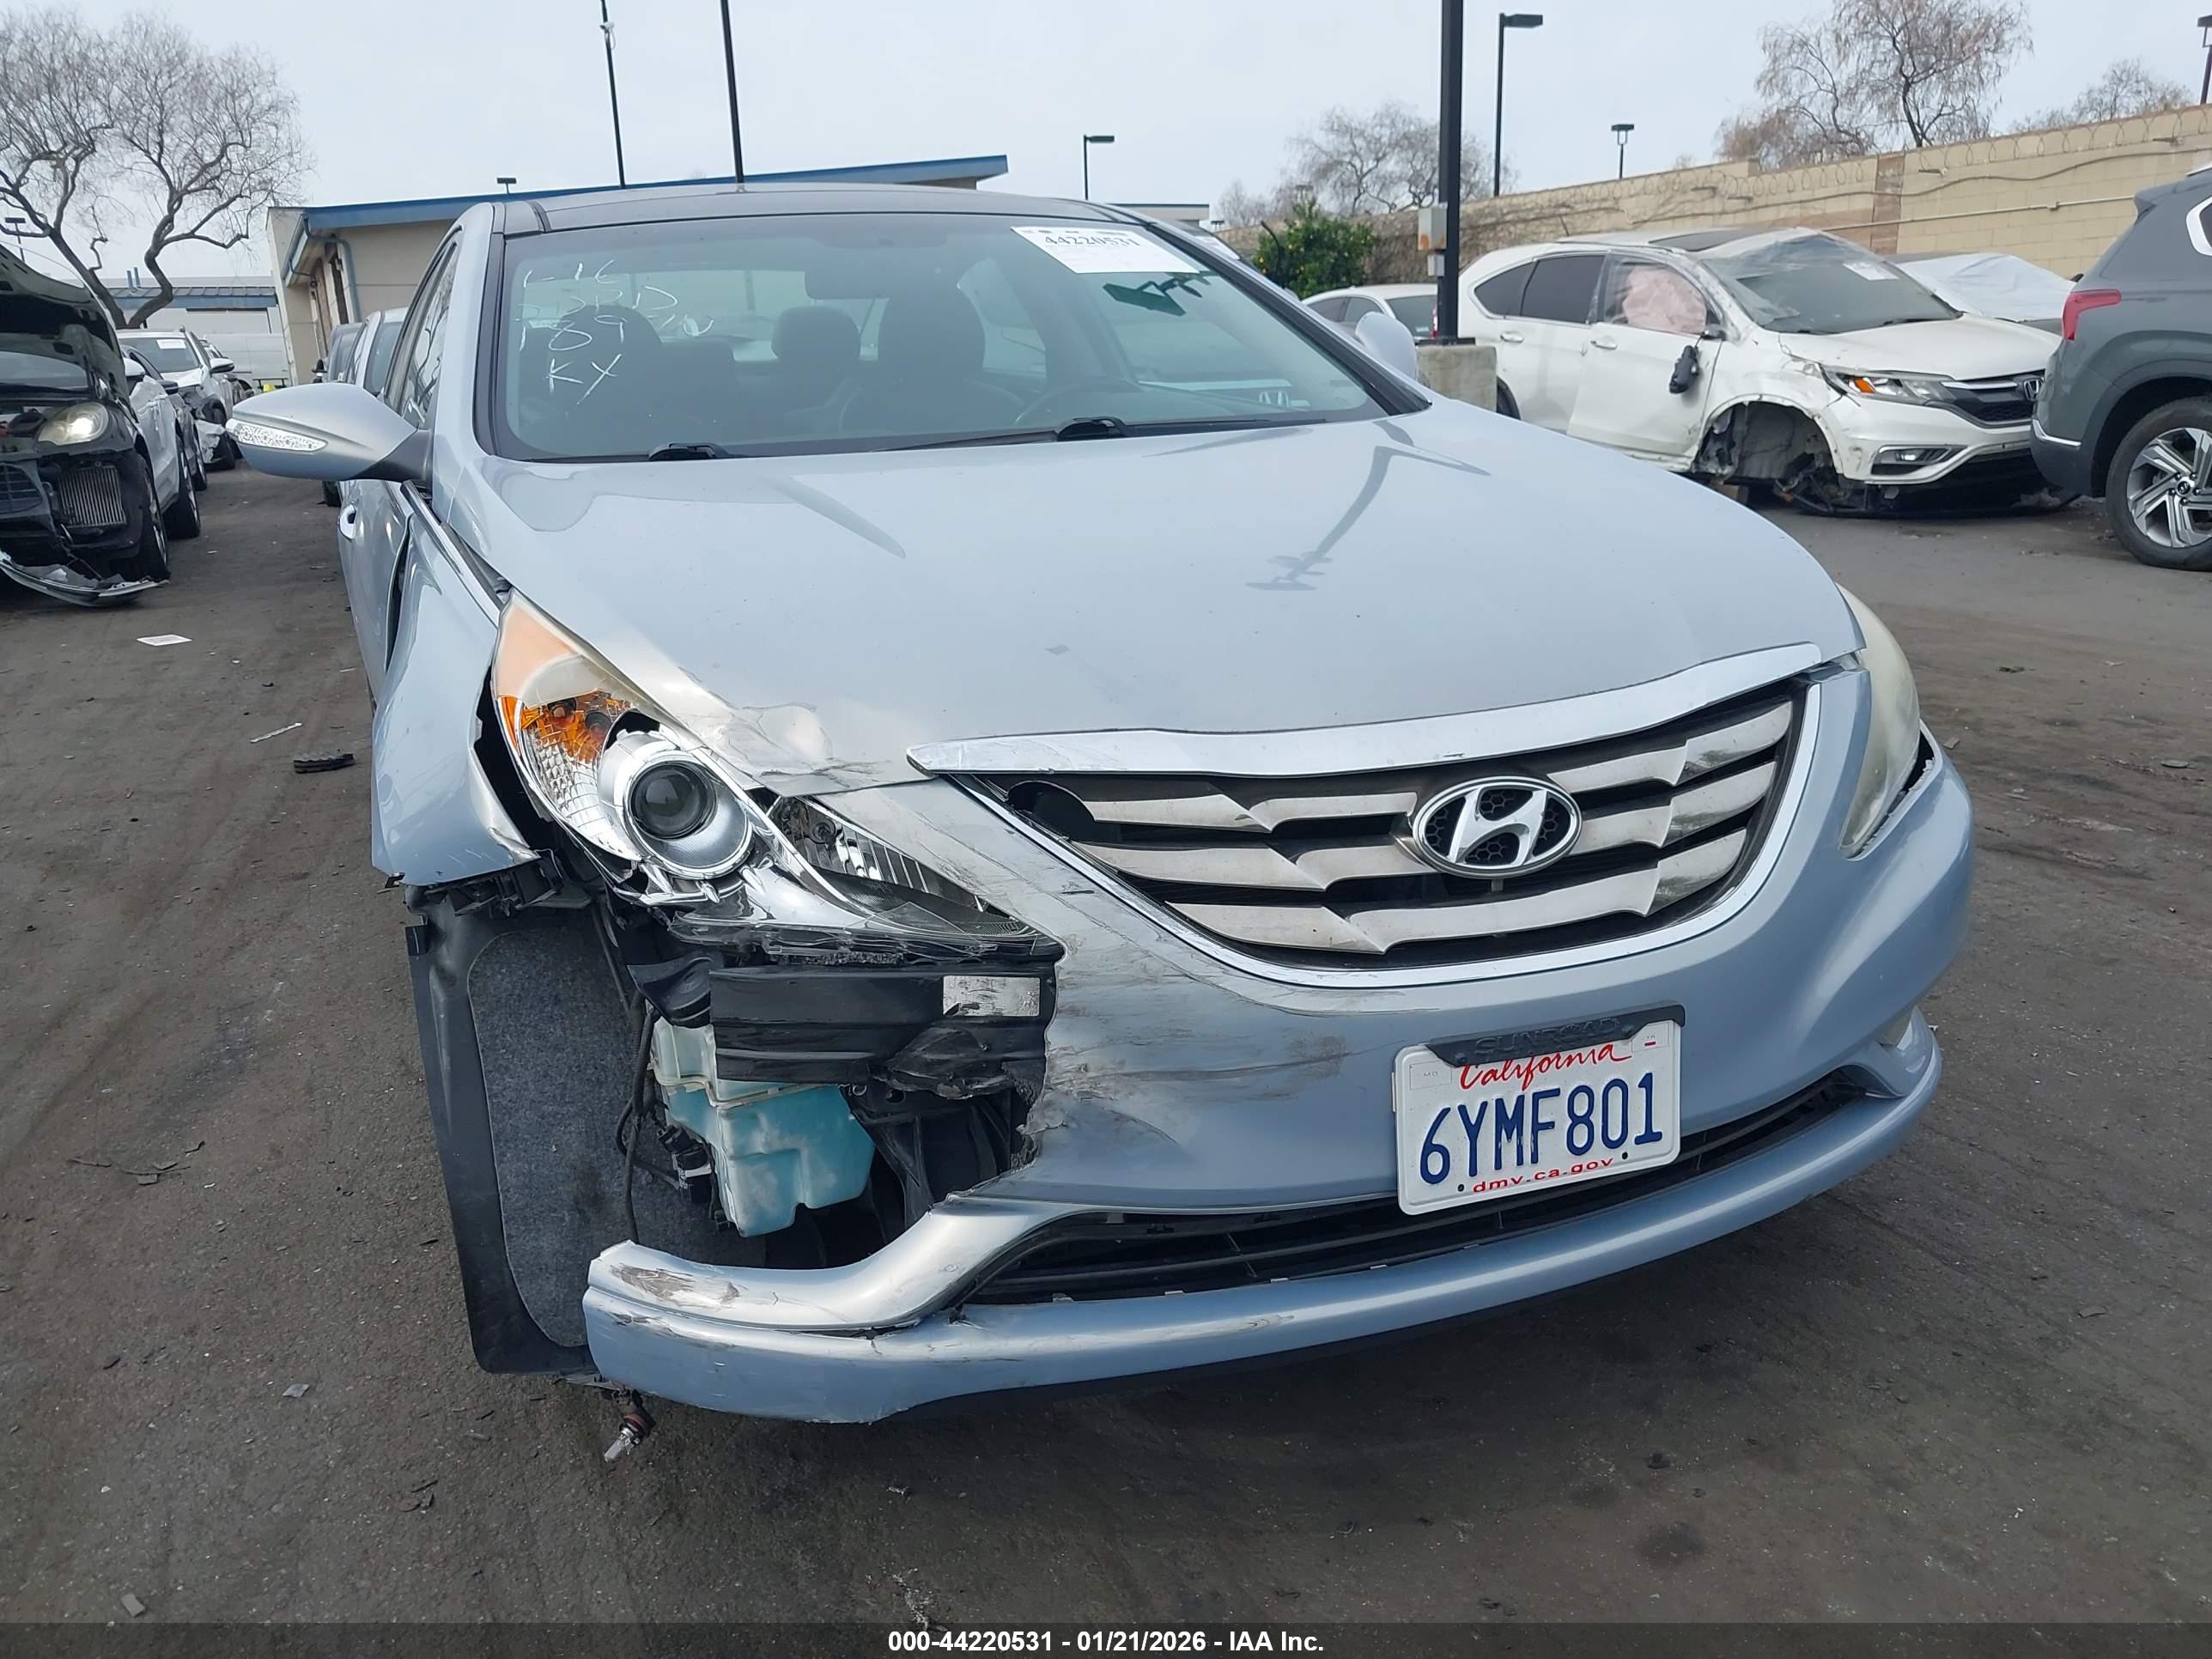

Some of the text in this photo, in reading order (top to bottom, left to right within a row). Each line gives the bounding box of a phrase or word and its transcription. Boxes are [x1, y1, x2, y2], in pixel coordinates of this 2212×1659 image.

[1459, 1044, 1632, 1091] California
[1419, 1072, 1663, 1185] 6YMF801
[1473, 1158, 1614, 1194] dmv.ca.gov
